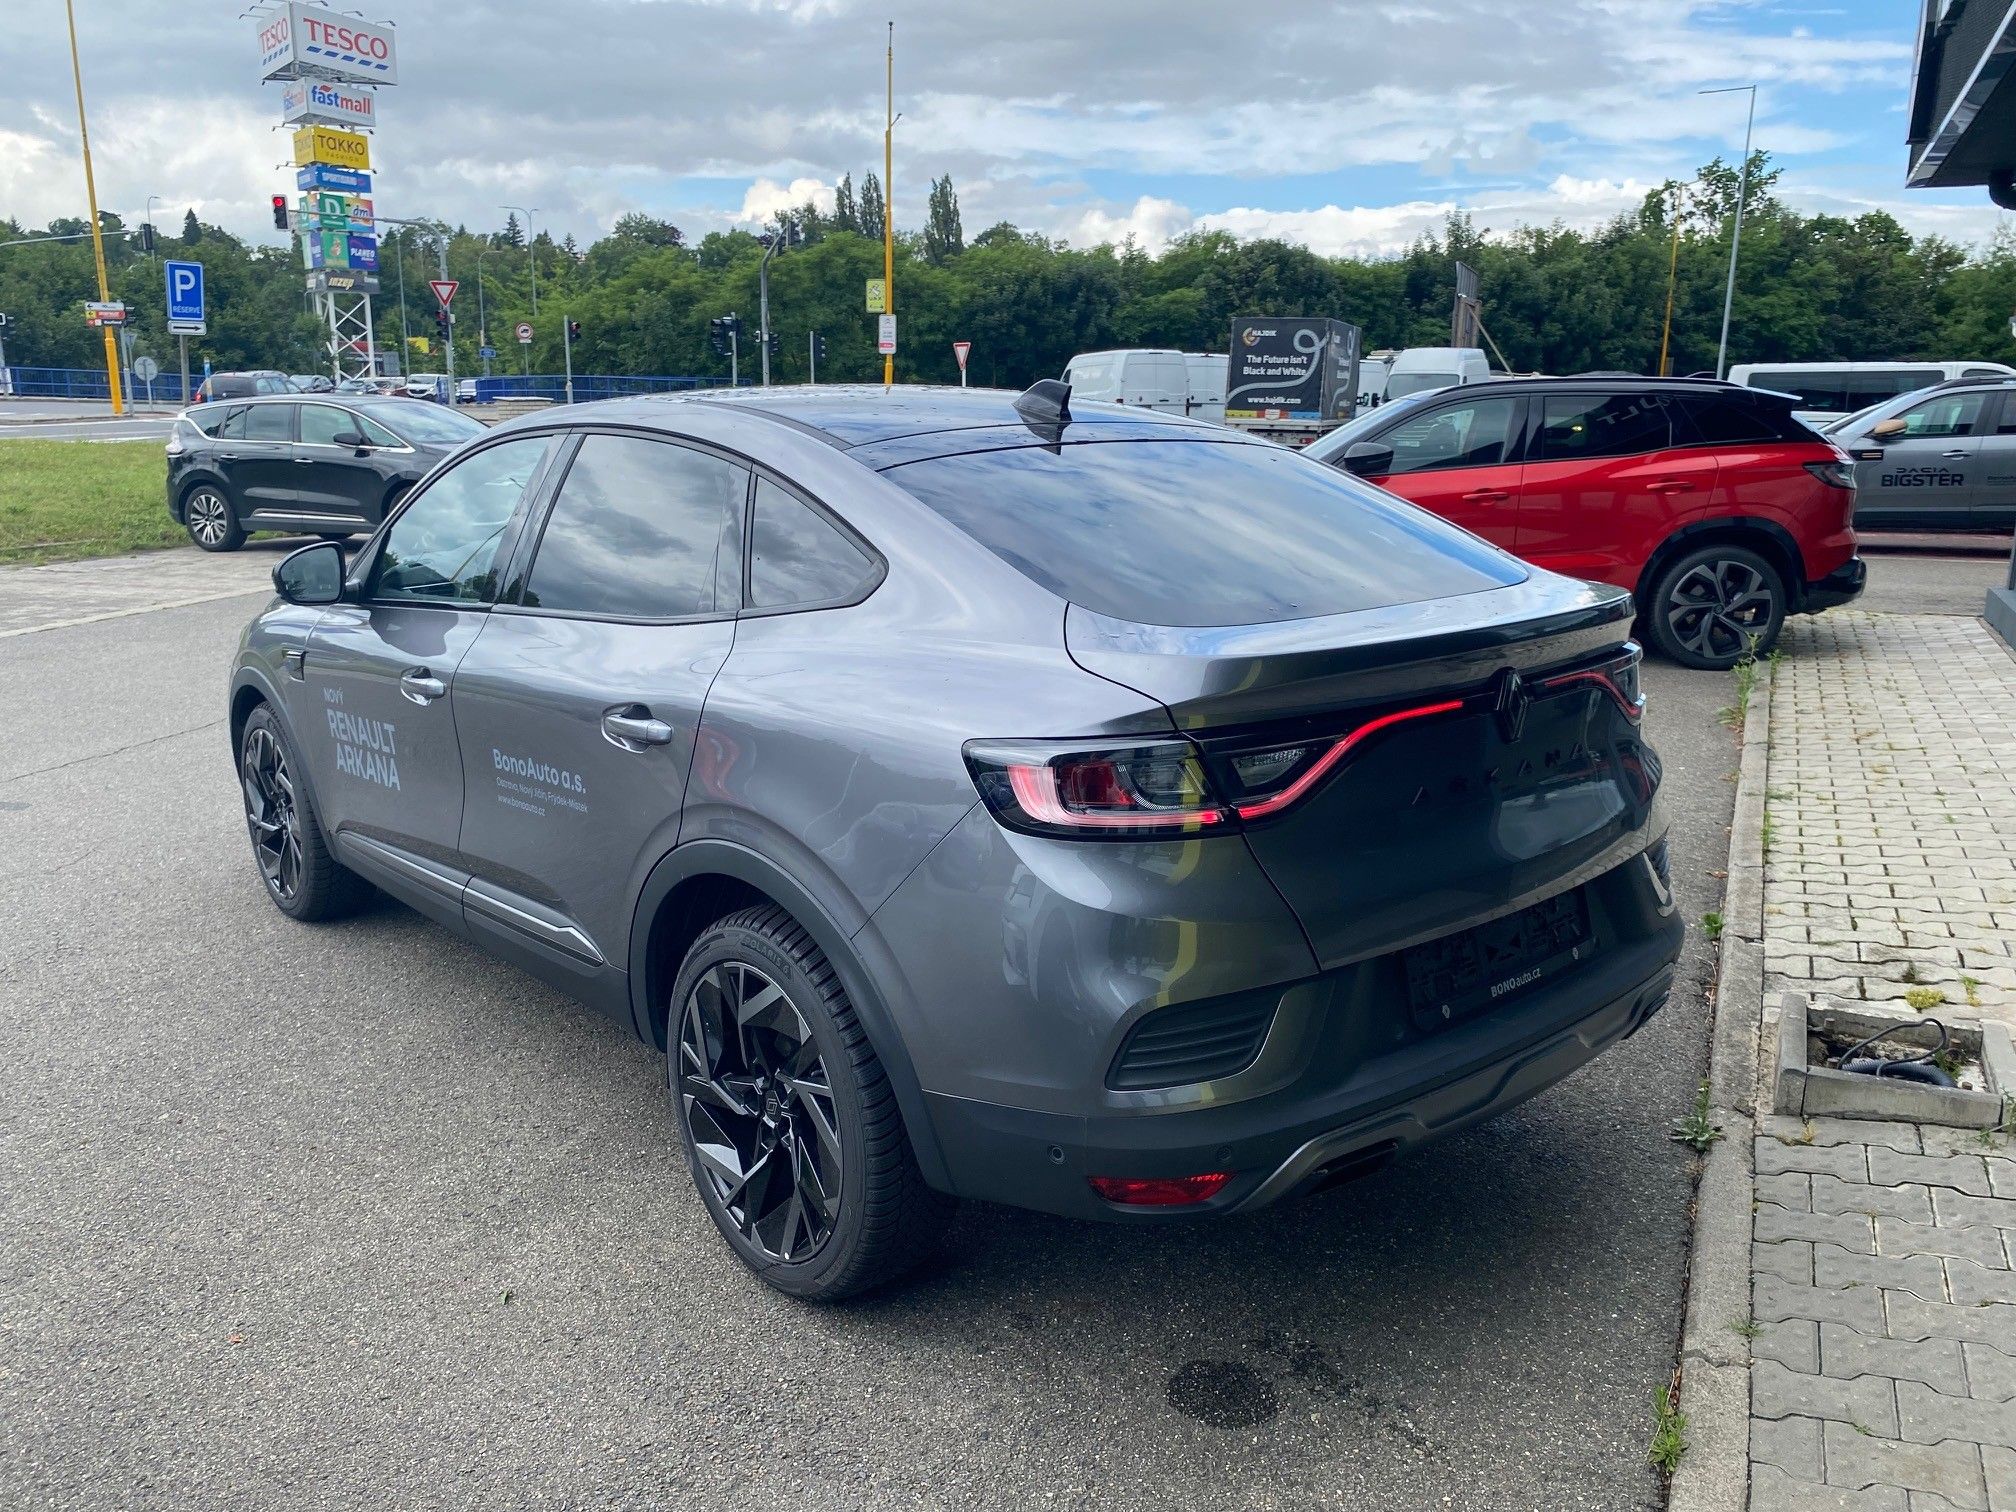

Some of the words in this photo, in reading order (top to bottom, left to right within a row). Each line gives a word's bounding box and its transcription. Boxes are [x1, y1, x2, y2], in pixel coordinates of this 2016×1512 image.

[259, 18, 288, 53] TESCO
[303, 17, 388, 60] TESCO
[311, 85, 371, 114] fastmall
[317, 135, 365, 155] TAKKO
[325, 199, 341, 219] D
[353, 205, 368, 216] dm
[350, 248, 375, 258] PLANEO
[175, 269, 195, 301] P
[1243, 366, 1266, 375] Black
[1267, 367, 1281, 375] and
[1282, 367, 1307, 376] White
[1246, 355, 1261, 363] The
[1263, 355, 1289, 364] Future
[1290, 355, 1308, 364] isn't
[1247, 396, 1302, 405] www.hajdik.com
[1881, 474, 1965, 487] BIGSTER
[327, 708, 396, 755] RENAULT
[337, 742, 401, 791] ARKANA
[493, 749, 559, 786] BonoAuto
[561, 770, 586, 794] a.s.
[1490, 967, 1543, 998] BONOauto.cz
